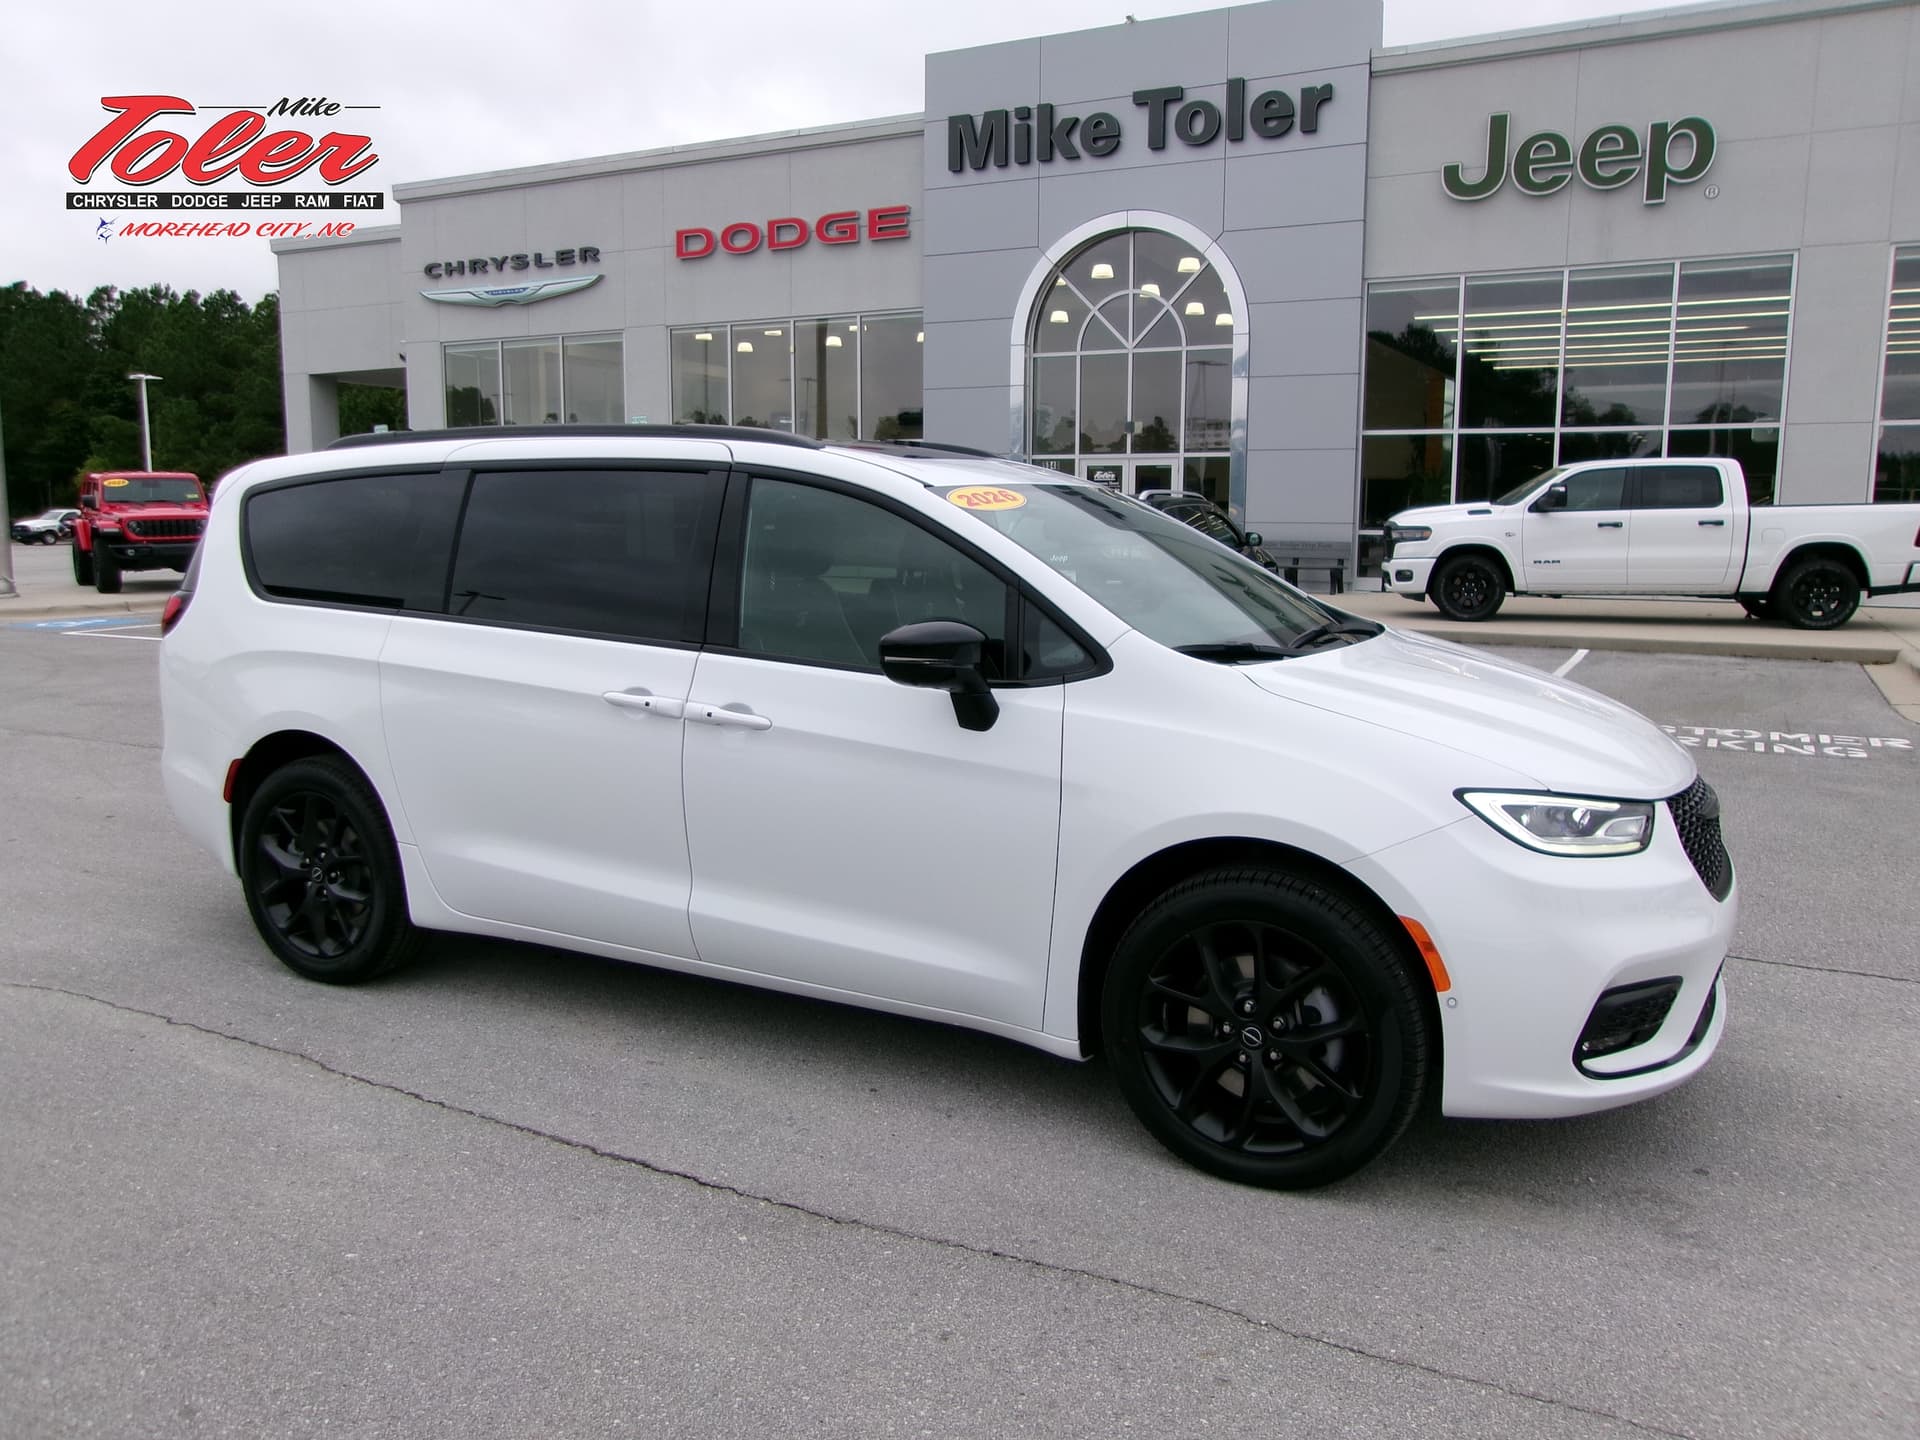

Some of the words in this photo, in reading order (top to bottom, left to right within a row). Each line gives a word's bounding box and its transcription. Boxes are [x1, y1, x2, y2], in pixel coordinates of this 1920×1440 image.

[947, 102, 1121, 173] Mike
[1132, 77, 1333, 150] Toler
[1441, 111, 1717, 205] Jeep
[675, 205, 911, 260] DODGE
[424, 245, 601, 280] CHRYSLER
[957, 490, 1019, 507] 2026
